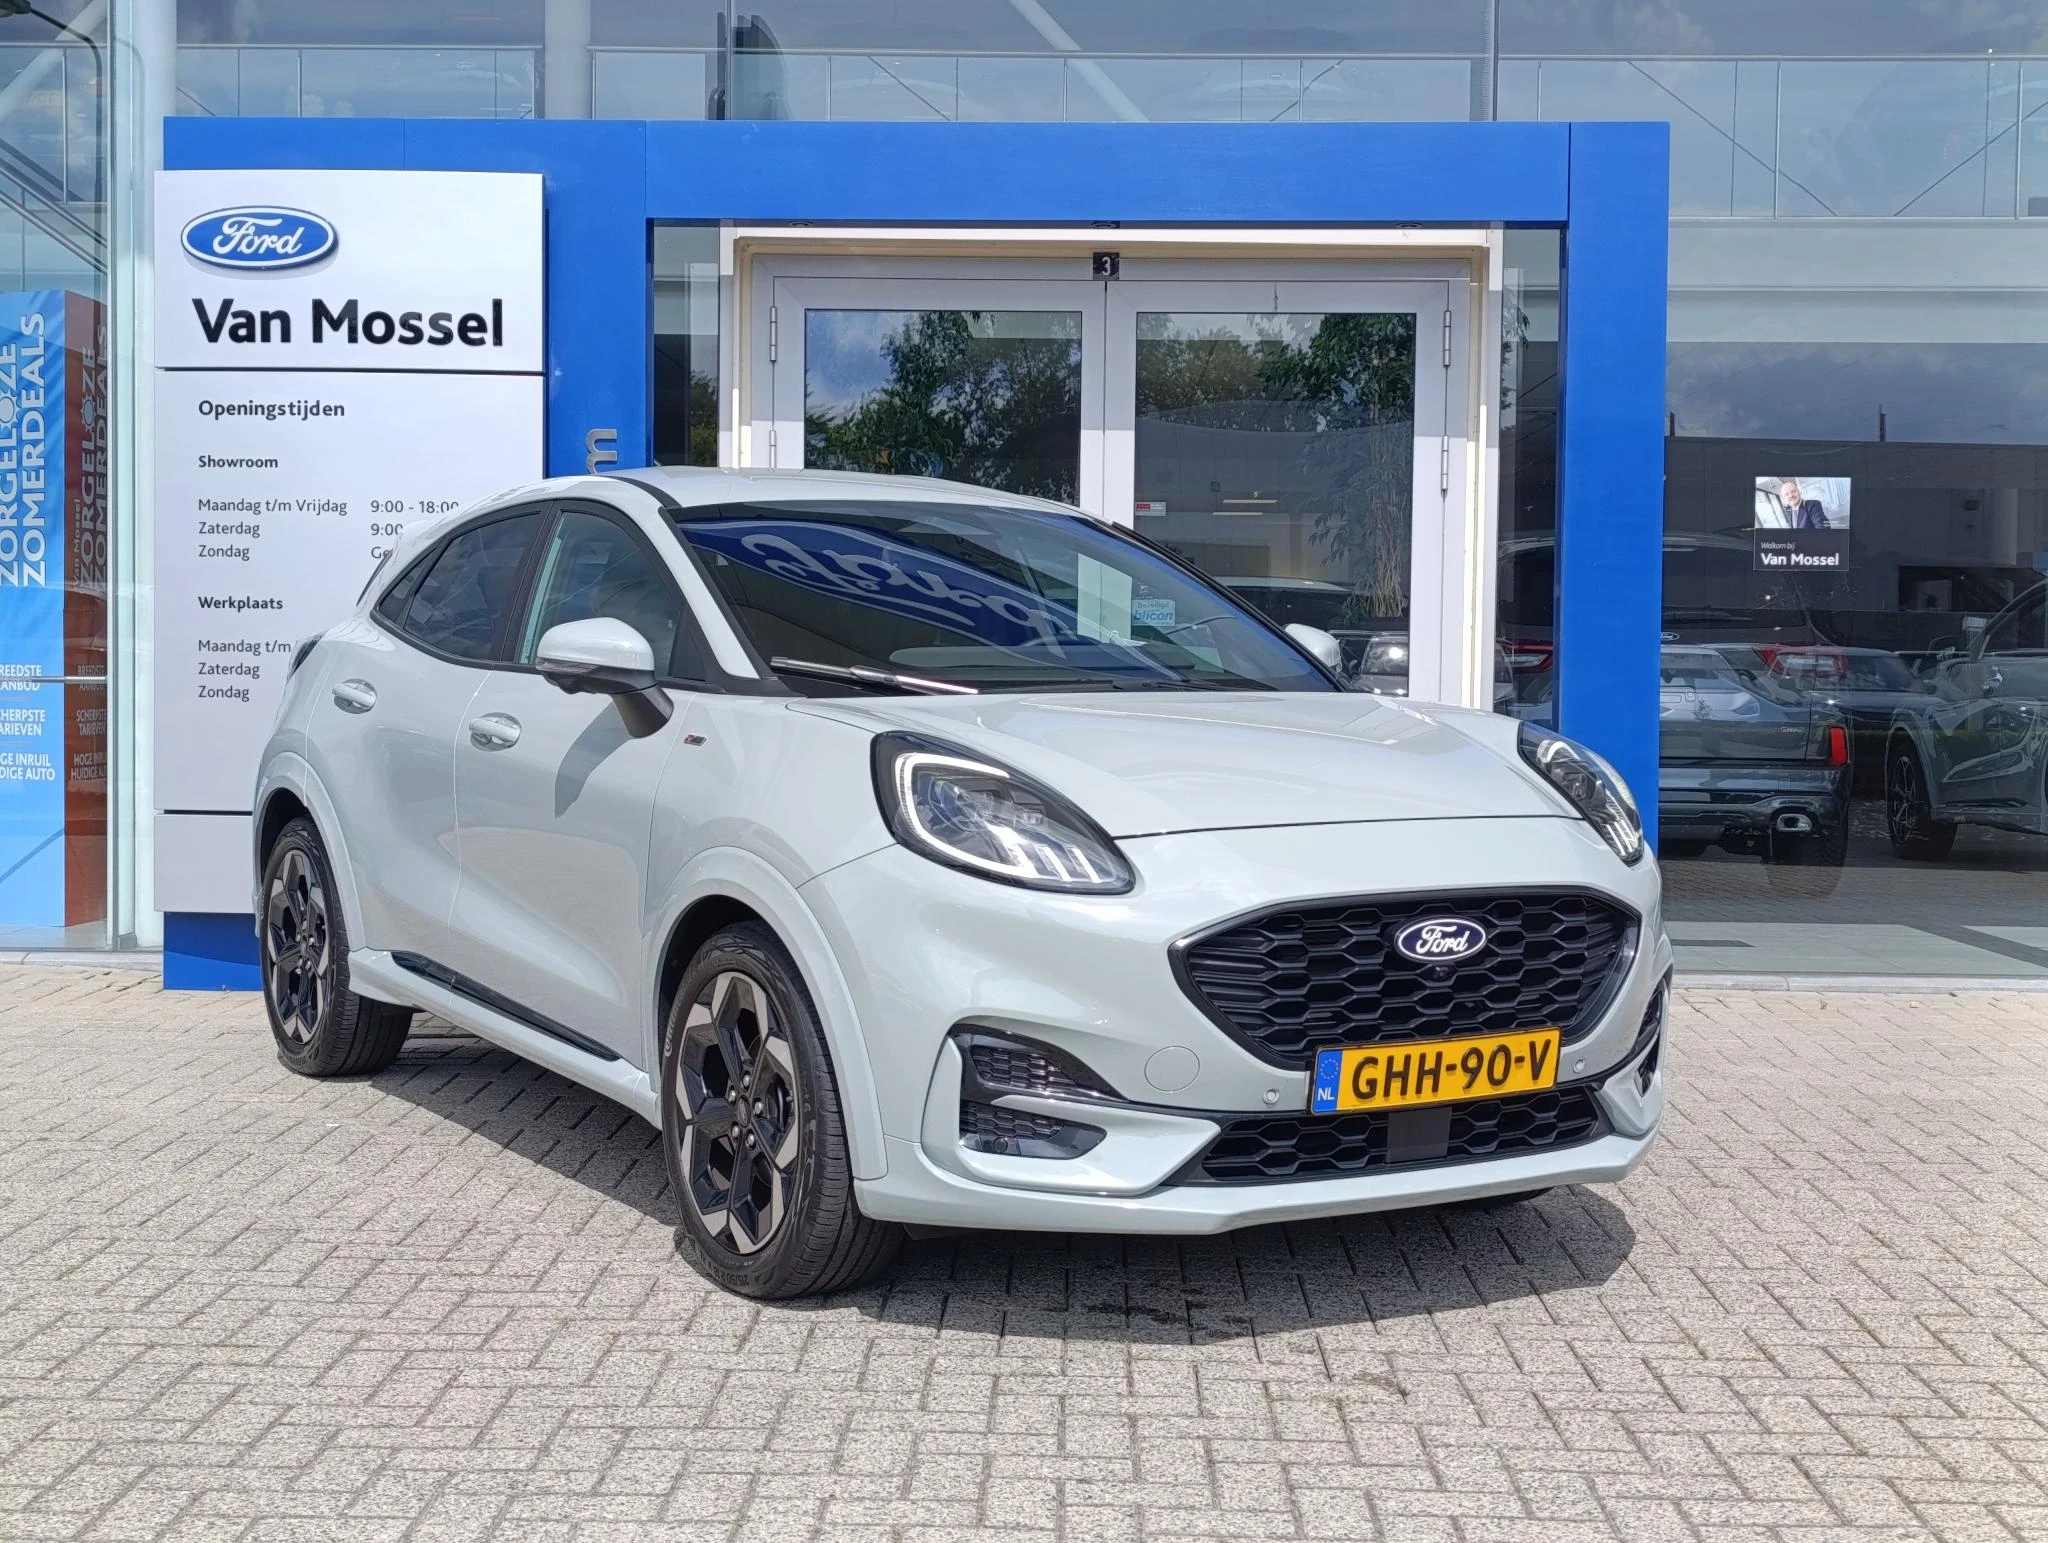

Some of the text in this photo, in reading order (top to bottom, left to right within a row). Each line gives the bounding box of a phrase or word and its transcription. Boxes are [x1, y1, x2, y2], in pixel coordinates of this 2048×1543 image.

[212, 216, 305, 254] Ford
[1102, 256, 1111, 276] 3
[192, 298, 503, 347] Van Mossel
[198, 400, 345, 421] Openingstijden
[20, 312, 46, 588] ZOMERDEALS
[198, 455, 279, 468] Showroom
[198, 498, 261, 516] Maandag
[265, 499, 292, 513] t/m
[296, 499, 348, 516] Vrijdag
[370, 500, 404, 513] 9:00
[198, 521, 260, 538] Zaterdag
[198, 544, 250, 561] Zondag
[1761, 541, 1786, 550] Welkom
[1761, 552, 1840, 566] Van Mossel
[198, 596, 283, 613] Werkplaats
[198, 639, 292, 656] Maandag t/m
[198, 662, 260, 679] Zaterdag
[198, 685, 250, 702] Zondag
[0, 709, 46, 721] HERPSTE
[16, 753, 51, 766] INRUIL
[25, 768, 56, 780] AUTO
[1416, 925, 1470, 954] Ford
[1317, 1039, 1552, 1101] NL GHH-90-V
